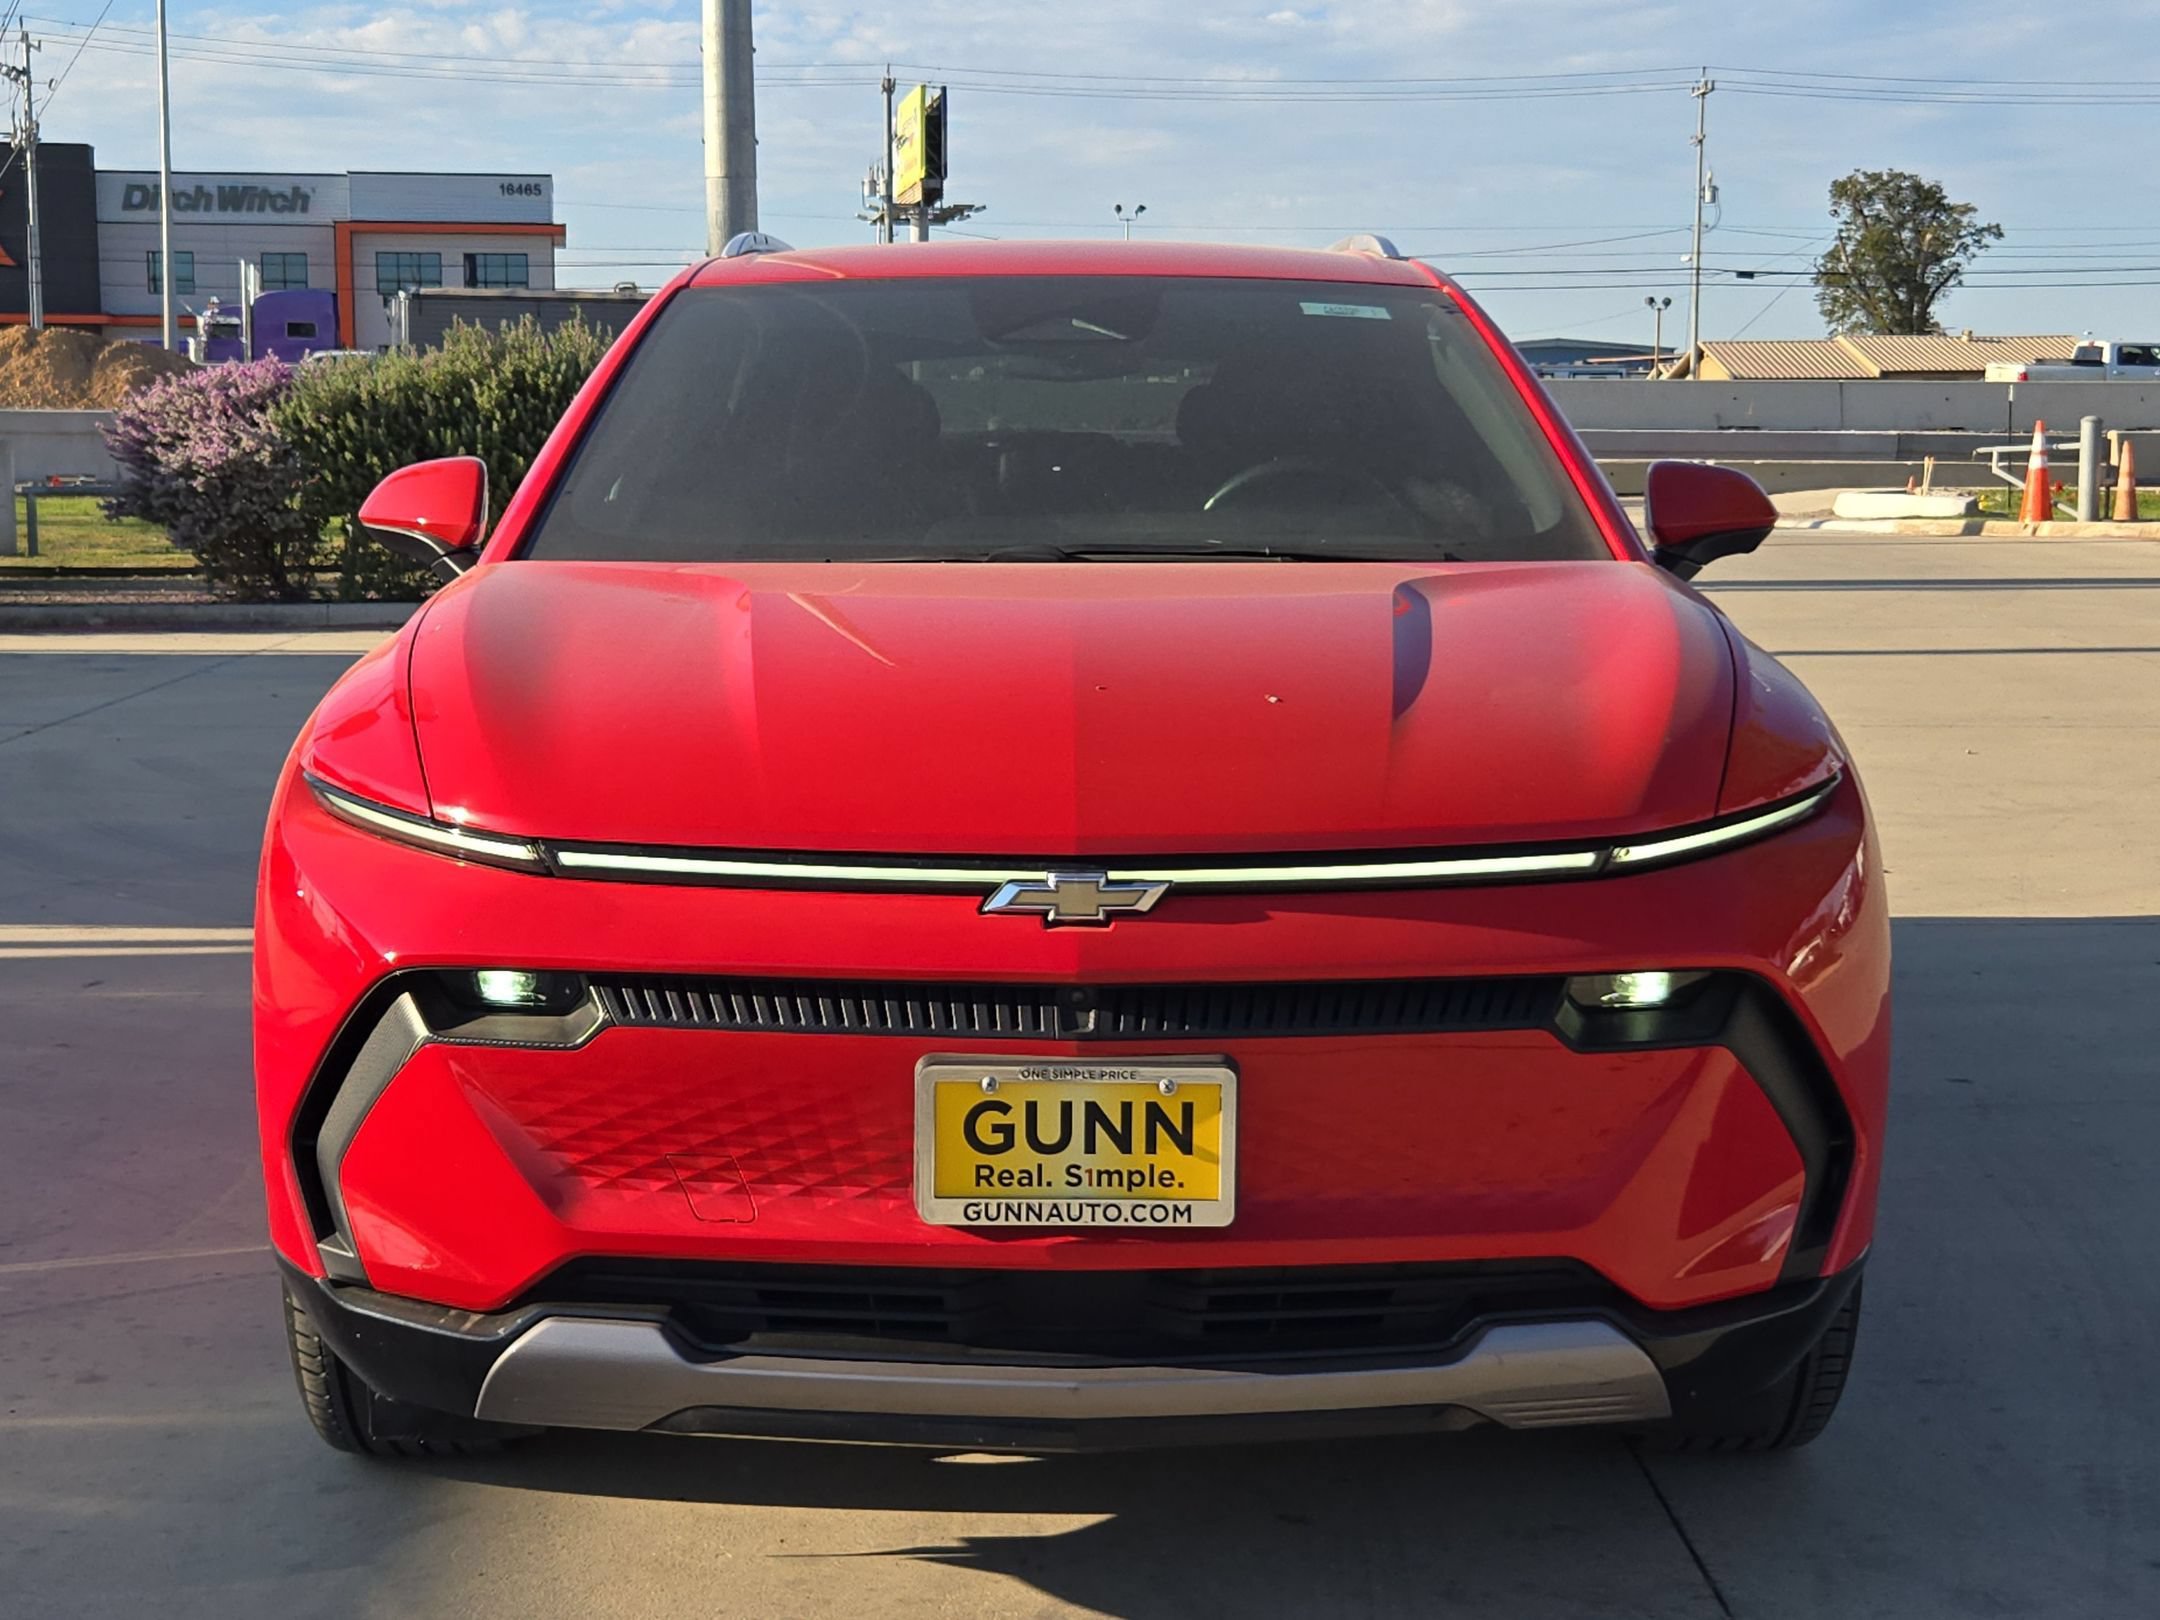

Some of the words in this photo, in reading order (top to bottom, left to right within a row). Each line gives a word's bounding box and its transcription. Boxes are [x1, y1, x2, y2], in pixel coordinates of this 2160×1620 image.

[121, 184, 214, 213] Dich
[216, 185, 312, 213] Witch
[499, 183, 542, 196] 16465
[1021, 1069, 1050, 1079] ONE
[1052, 1069, 1097, 1080] SIMPLE
[1100, 1070, 1137, 1080] PRICE
[963, 1100, 1194, 1156] GUNN
[975, 1164, 1052, 1188] Real.
[963, 1202, 1192, 1224] GUNNAUTO.COM
